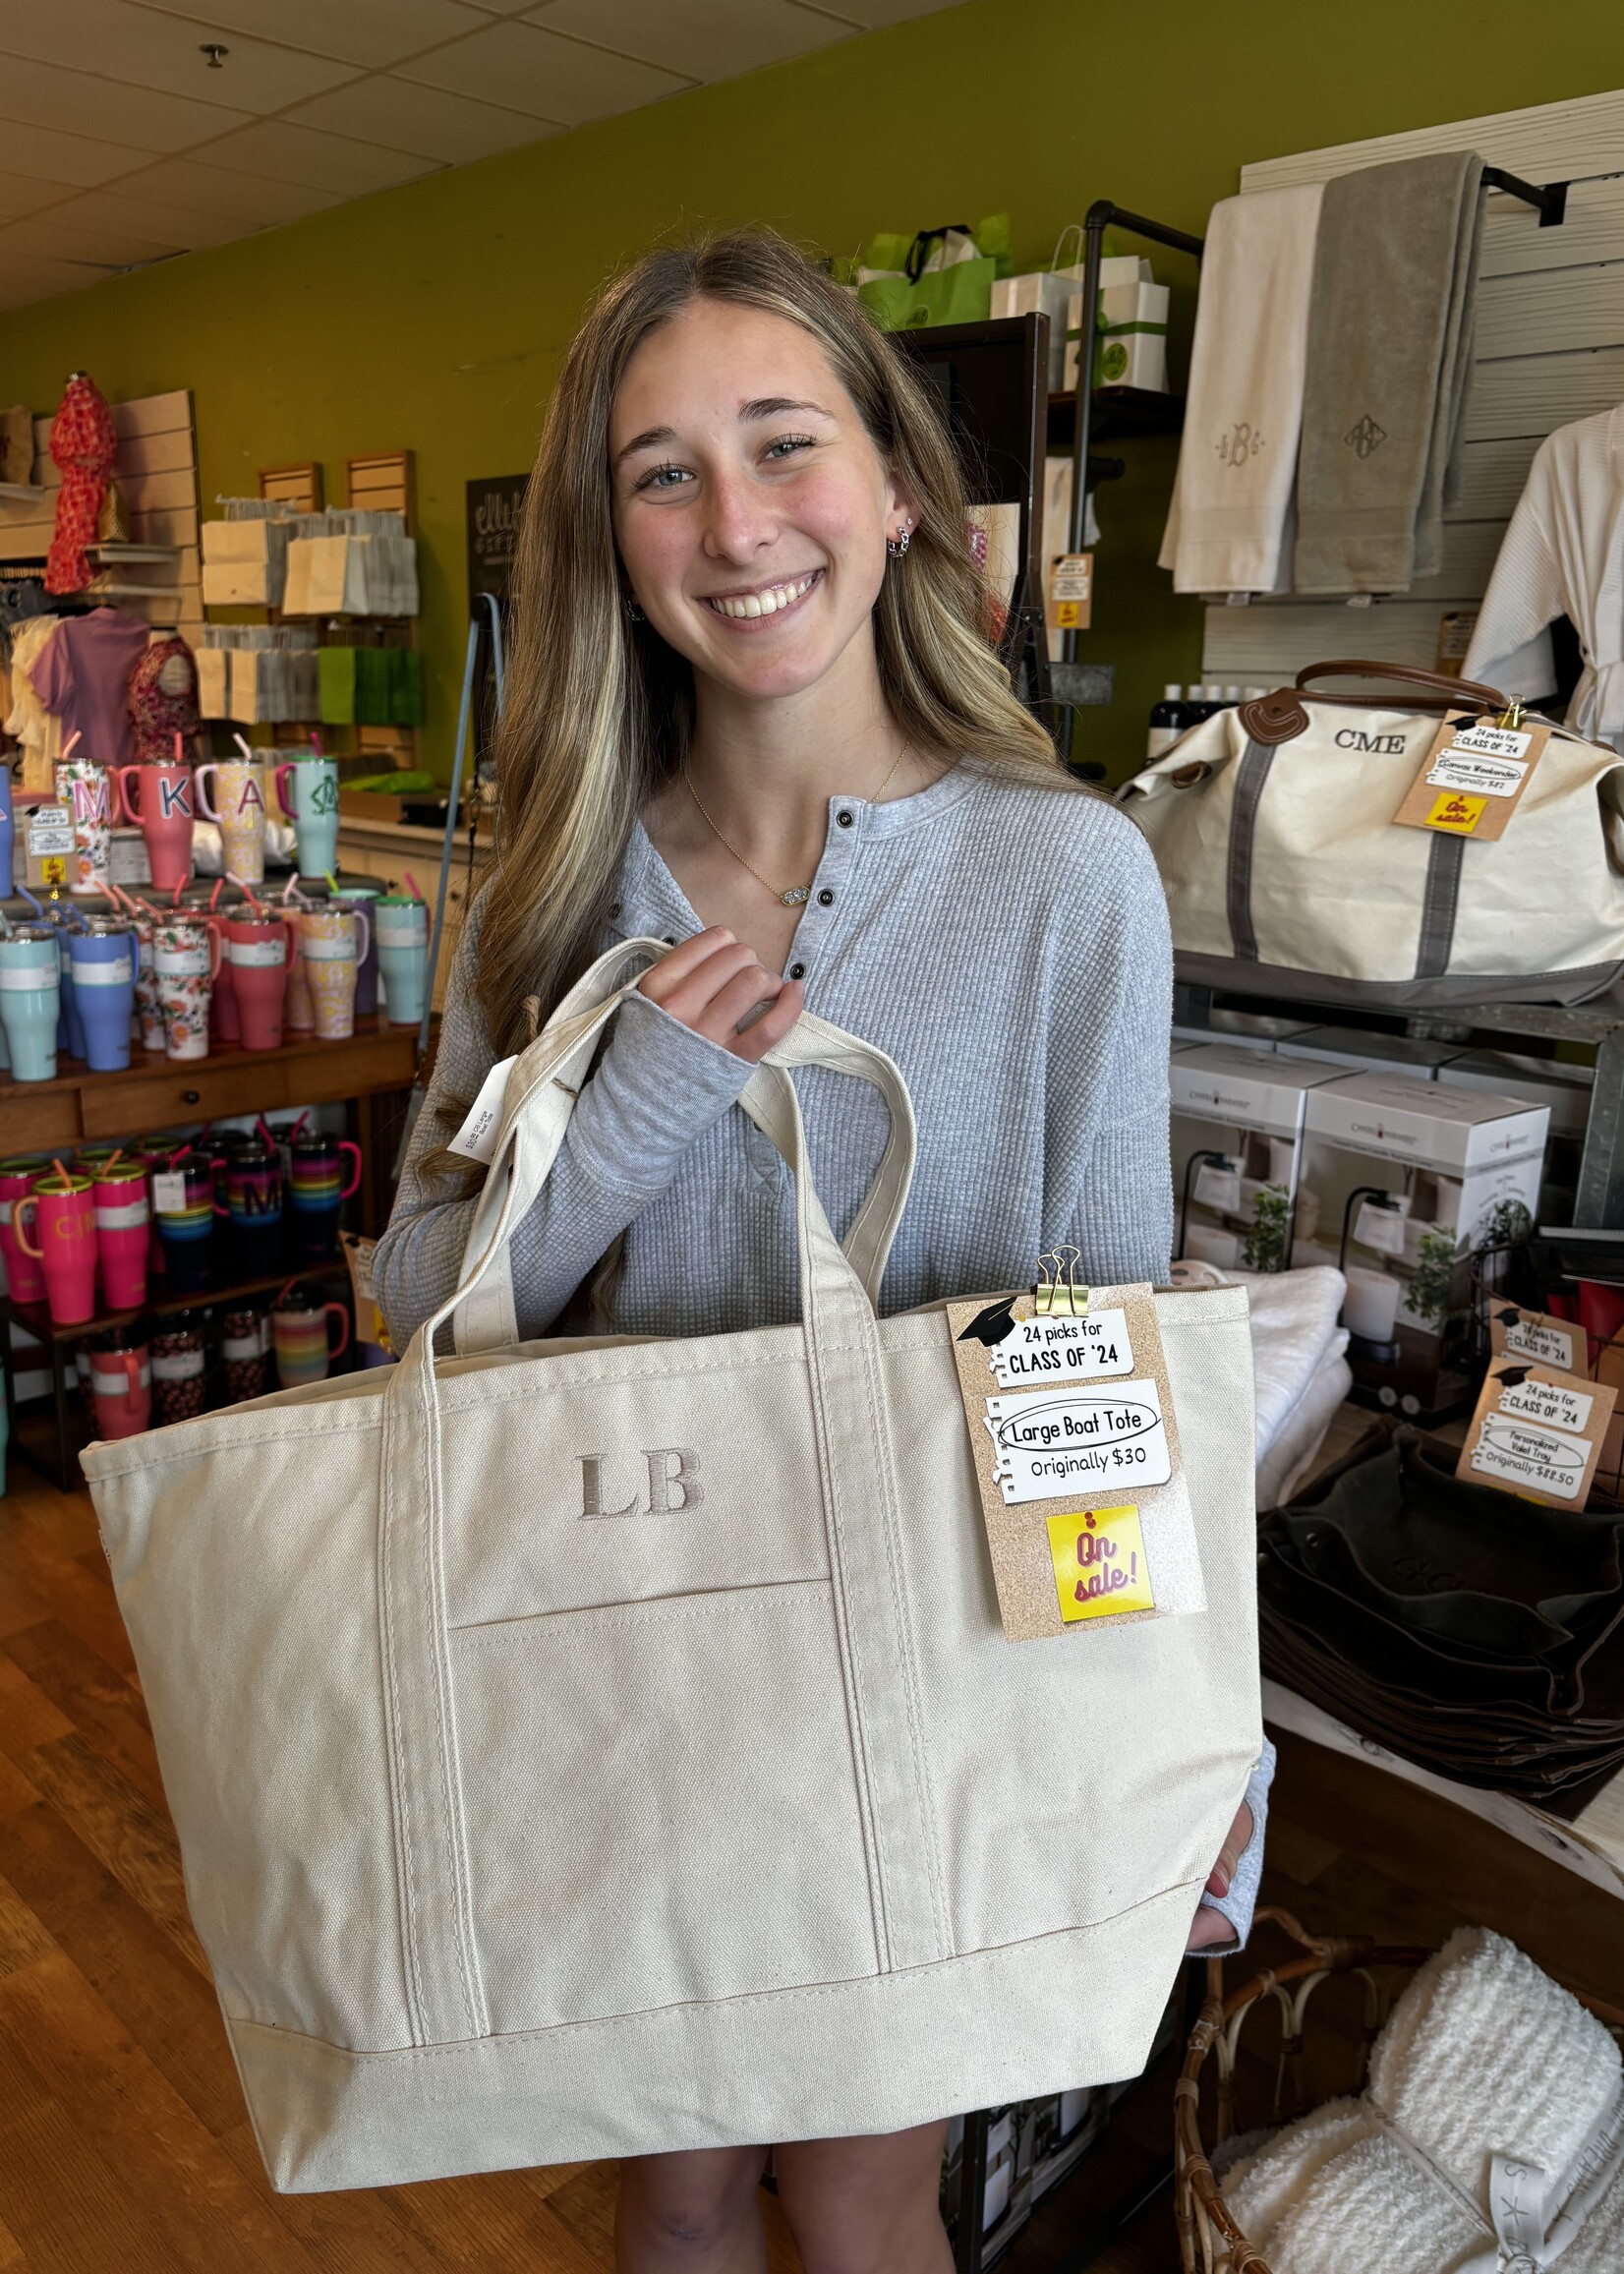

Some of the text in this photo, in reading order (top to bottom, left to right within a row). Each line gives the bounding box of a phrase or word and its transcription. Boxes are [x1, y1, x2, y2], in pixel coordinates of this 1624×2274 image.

[1334, 729, 1406, 754] CME
[1461, 736, 1488, 748] CLASS
[1490, 741, 1503, 750] OF
[1476, 728, 1518, 742] 24 picks for
[1445, 774, 1487, 787] Originally
[1473, 764, 1518, 780] Weekender
[73, 779, 112, 820] M
[159, 776, 192, 818] K
[237, 777, 264, 816] A
[1445, 801, 1469, 812] On
[1435, 813, 1477, 824] sale!
[243, 1176, 281, 1217] M
[1022, 1319, 1103, 1346] 24 picks for
[1514, 1335, 1538, 1353] CLASS
[1540, 1342, 1550, 1355] OF
[1010, 1349, 1062, 1373] CLASS
[1067, 1347, 1086, 1368] OF
[1509, 1396, 1542, 1414] CLASS
[1543, 1404, 1558, 1419] OF
[1526, 1383, 1576, 1407] 24 picks for
[1012, 1410, 1141, 1445] Large Boat Tote
[1509, 1430, 1559, 1453] Personalized
[1511, 1442, 1551, 1465] Valet Tray
[1030, 1446, 1146, 1479] Originally $30
[1485, 1451, 1574, 1487] Originally $88.50
[574, 1447, 705, 1522] LB
[1076, 1532, 1118, 1568] On
[1073, 1550, 1138, 1603] sale!
